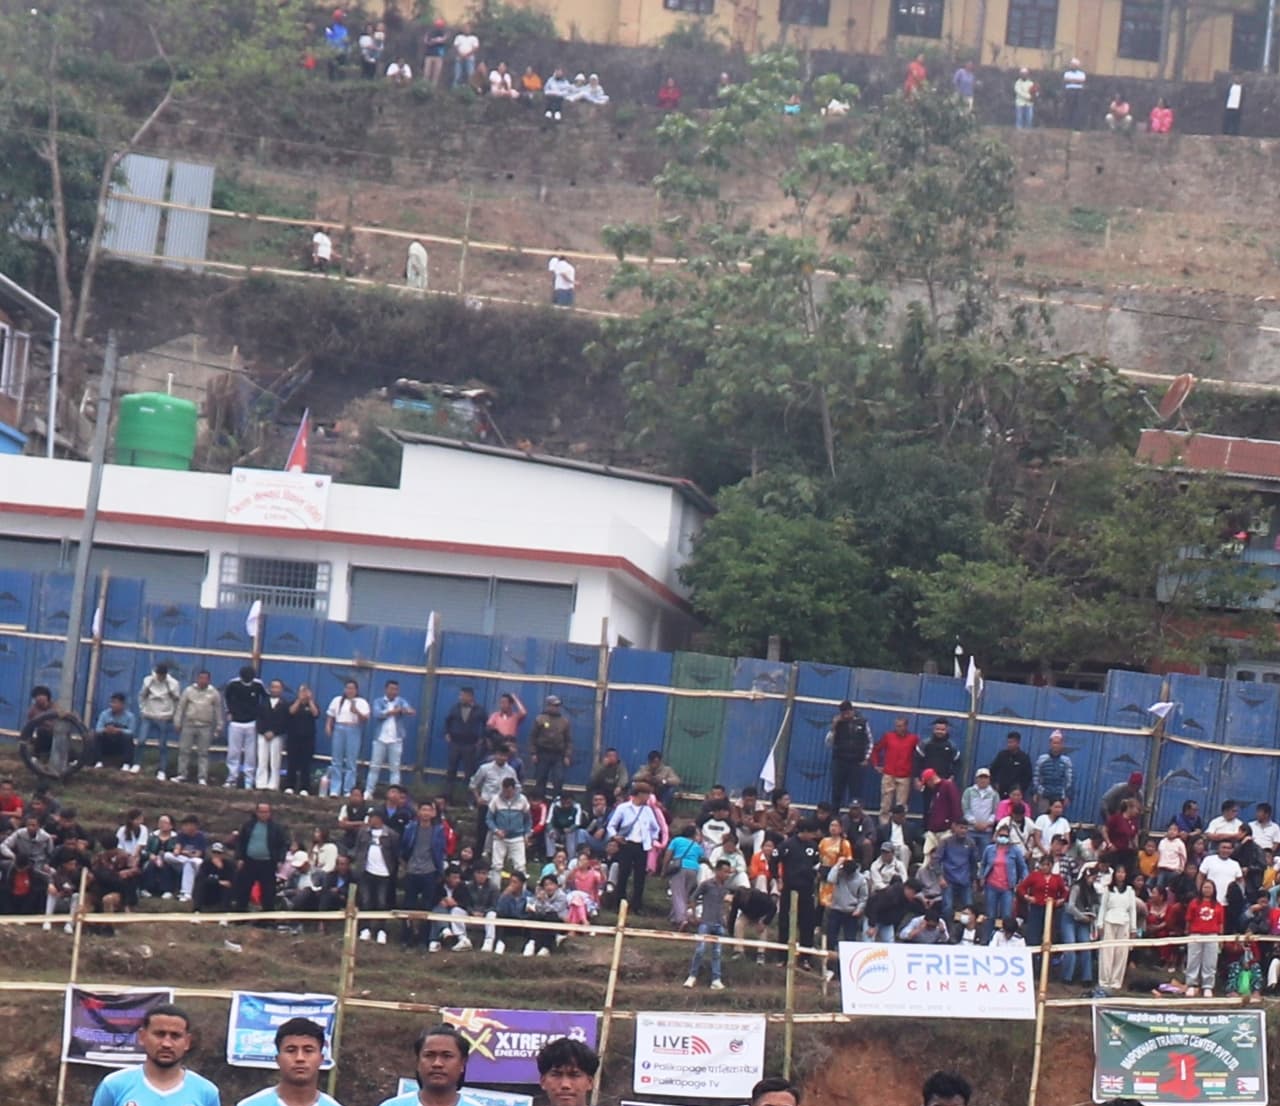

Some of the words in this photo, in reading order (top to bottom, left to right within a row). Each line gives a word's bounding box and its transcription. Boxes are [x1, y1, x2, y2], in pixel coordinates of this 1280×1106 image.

[906, 953, 1025, 977] FRIENDS
[907, 980, 1026, 993] CINEMAS
[653, 1034, 690, 1049] LIVE
[1156, 1034, 1189, 1047] TRAINING
[1189, 1035, 1217, 1054] CENTER
[494, 1049, 533, 1058] ENERGY
